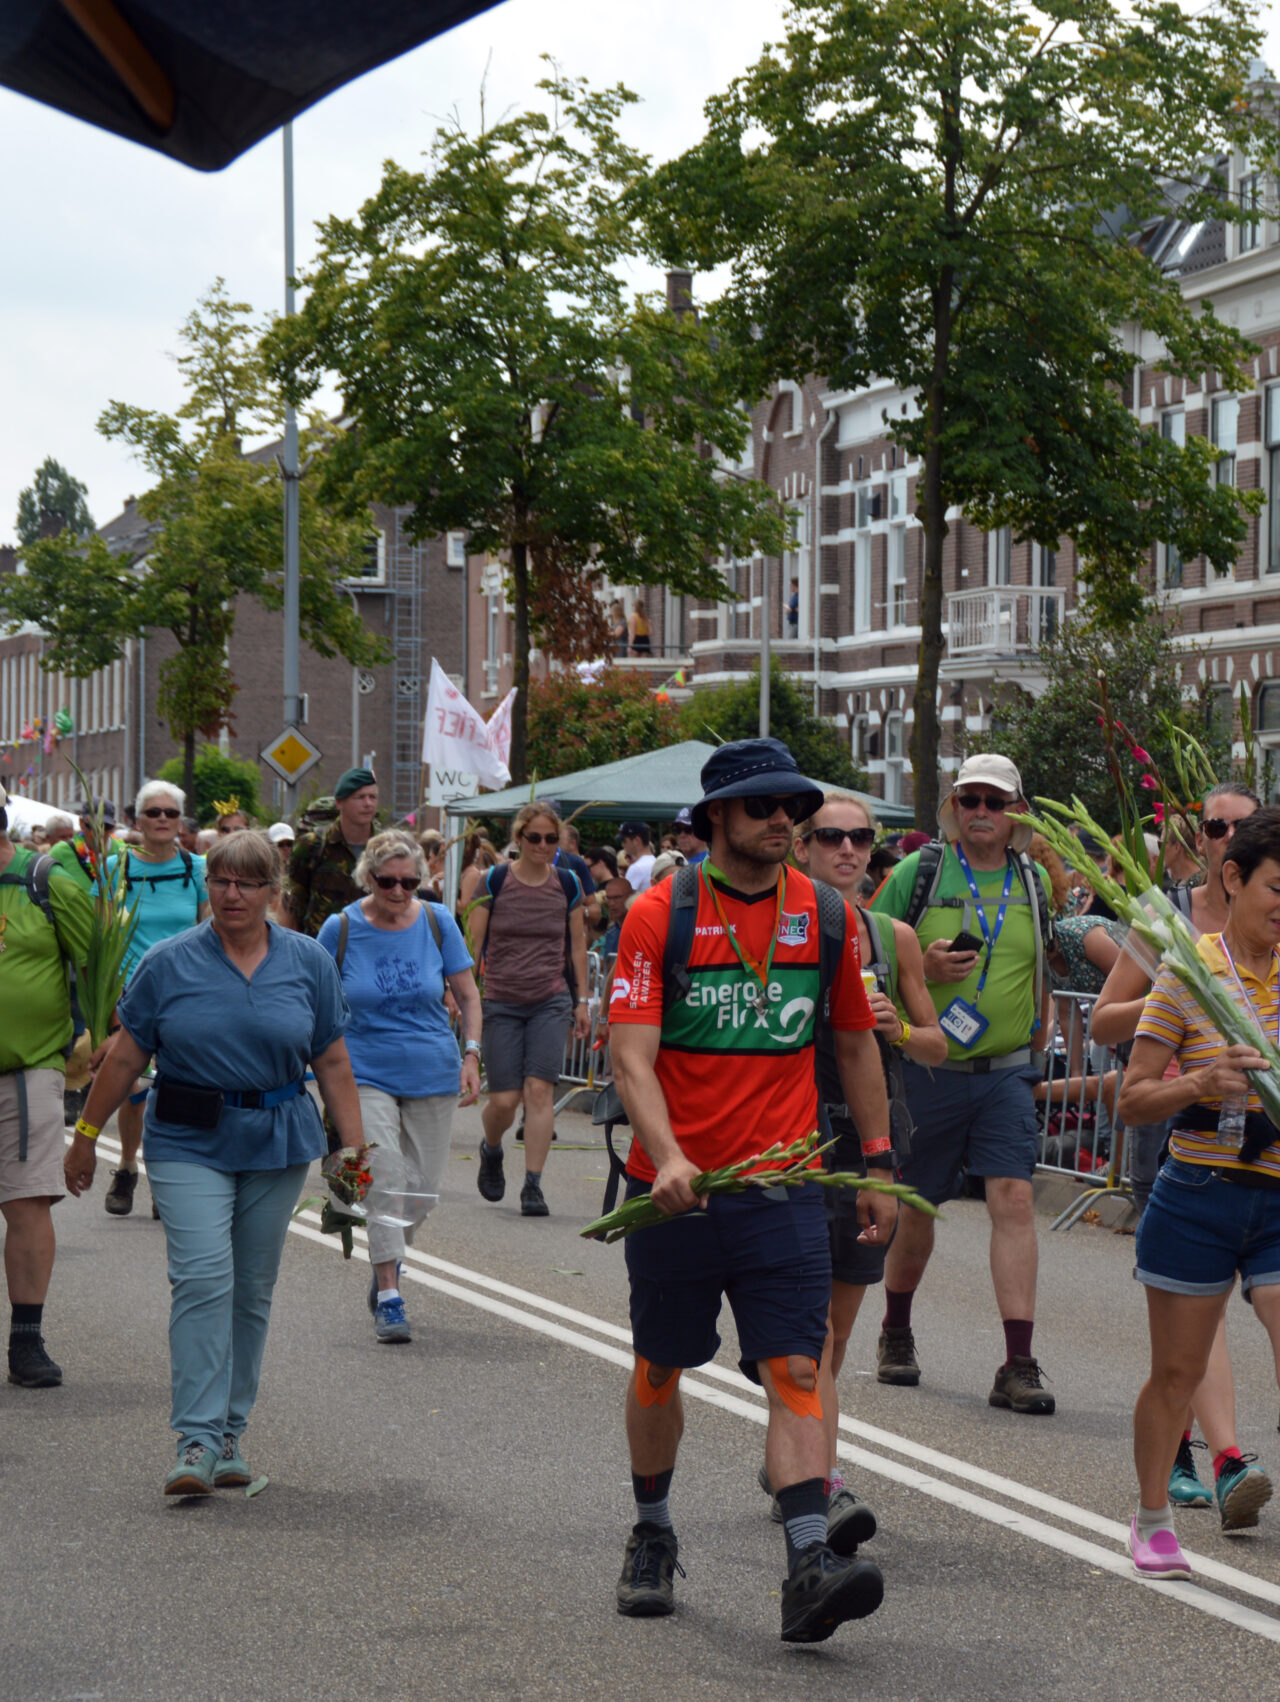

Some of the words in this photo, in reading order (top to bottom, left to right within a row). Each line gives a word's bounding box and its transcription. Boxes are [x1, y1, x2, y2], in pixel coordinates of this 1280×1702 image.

[435, 769, 471, 787] WC
[695, 924, 737, 936] PATRIK
[781, 924, 805, 936] NEC
[629, 951, 643, 1009] SCHOLTEN
[640, 961, 652, 1003] AWATER
[685, 981, 783, 1007] Energe
